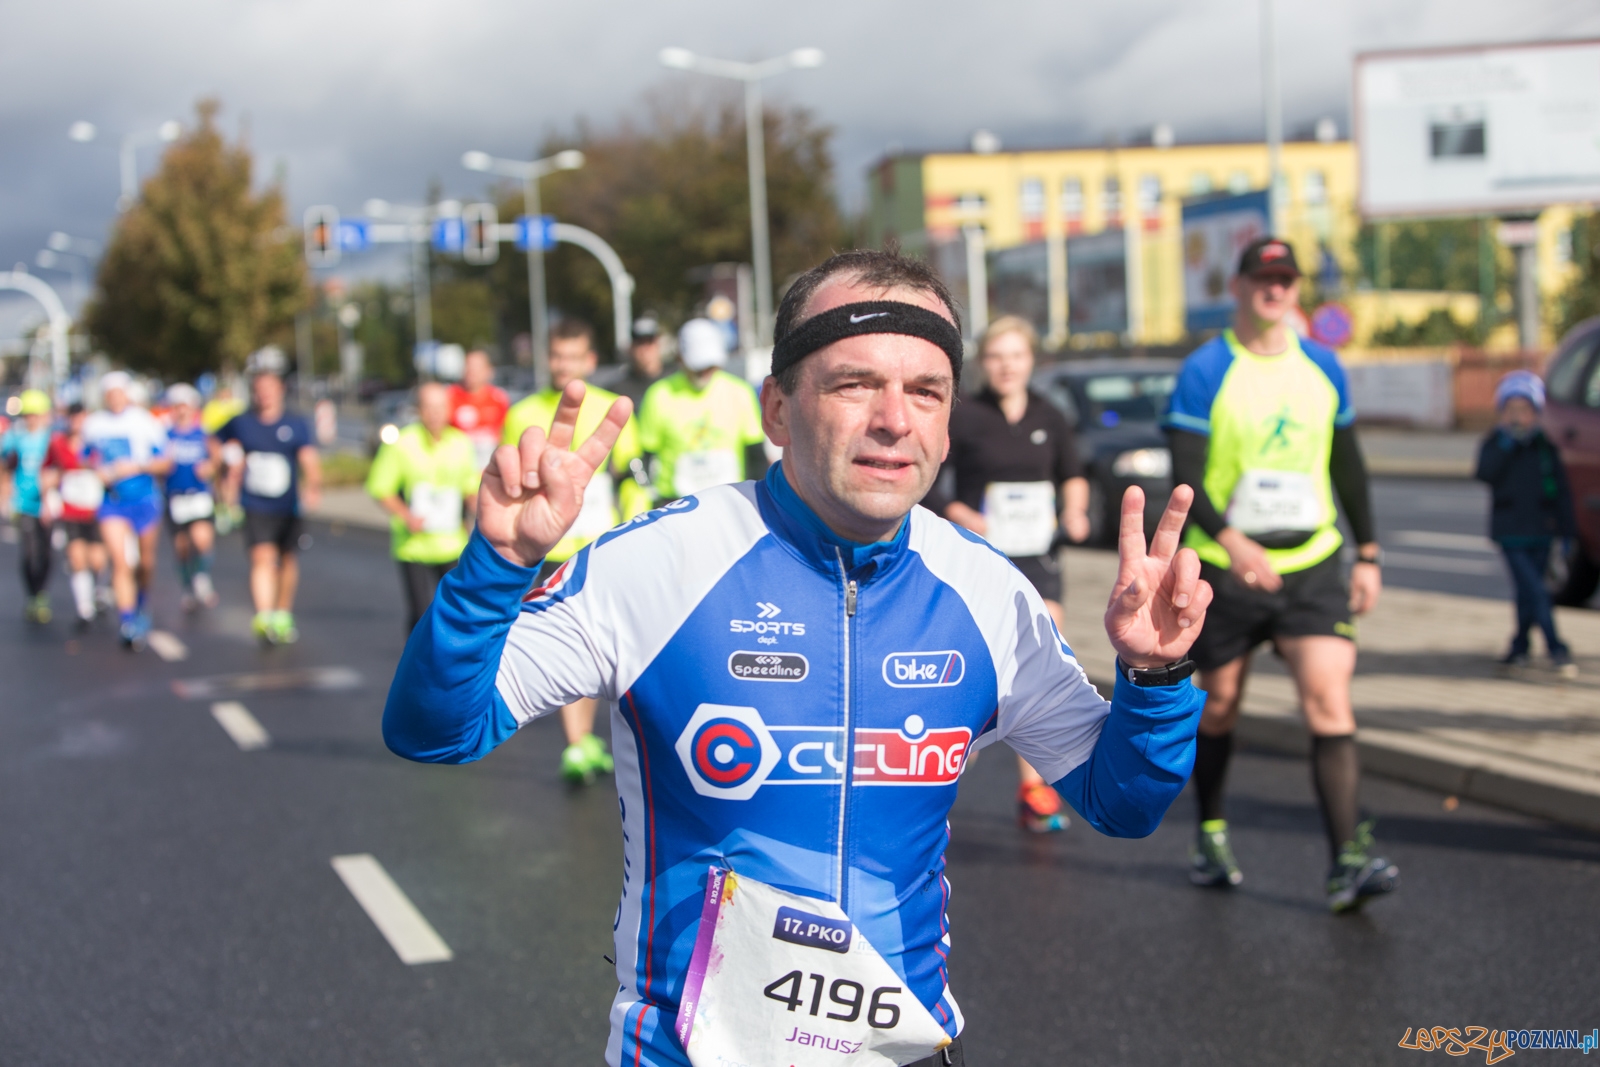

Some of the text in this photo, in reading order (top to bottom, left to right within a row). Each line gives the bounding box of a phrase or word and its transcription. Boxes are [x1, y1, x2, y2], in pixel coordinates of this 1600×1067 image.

[730, 619, 806, 636] SPORTS
[734, 665, 802, 676] speedline
[894, 658, 938, 680] bike
[783, 917, 804, 936] 17.
[807, 923, 846, 944] PKO
[763, 970, 902, 1029] 4196
[785, 1026, 863, 1054] Janusz
